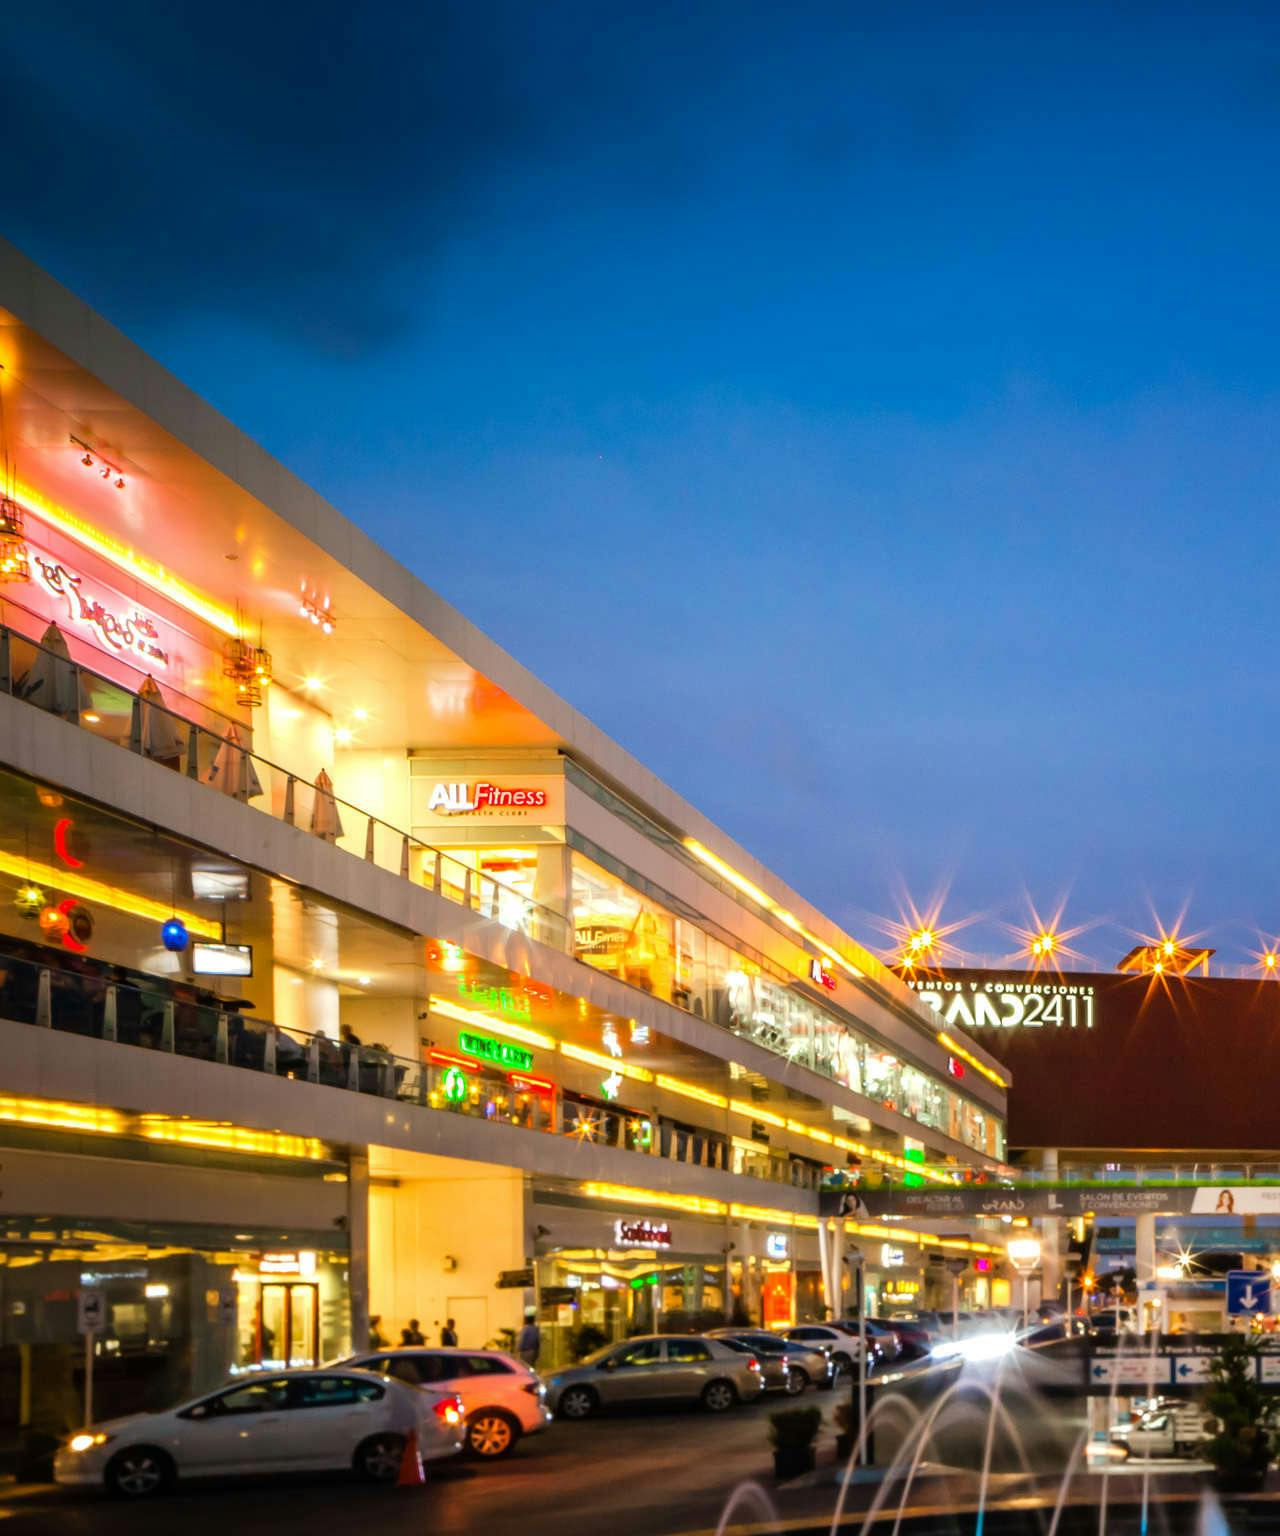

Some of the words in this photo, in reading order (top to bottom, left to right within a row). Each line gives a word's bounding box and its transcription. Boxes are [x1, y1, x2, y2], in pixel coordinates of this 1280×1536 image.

[428, 783, 474, 811] ALL
[473, 783, 546, 810] Fitness
[907, 981, 962, 992] VENTOS
[970, 982, 978, 991] Y
[985, 983, 1095, 996] CONVENCIONES
[919, 991, 1095, 1028] RAND2411
